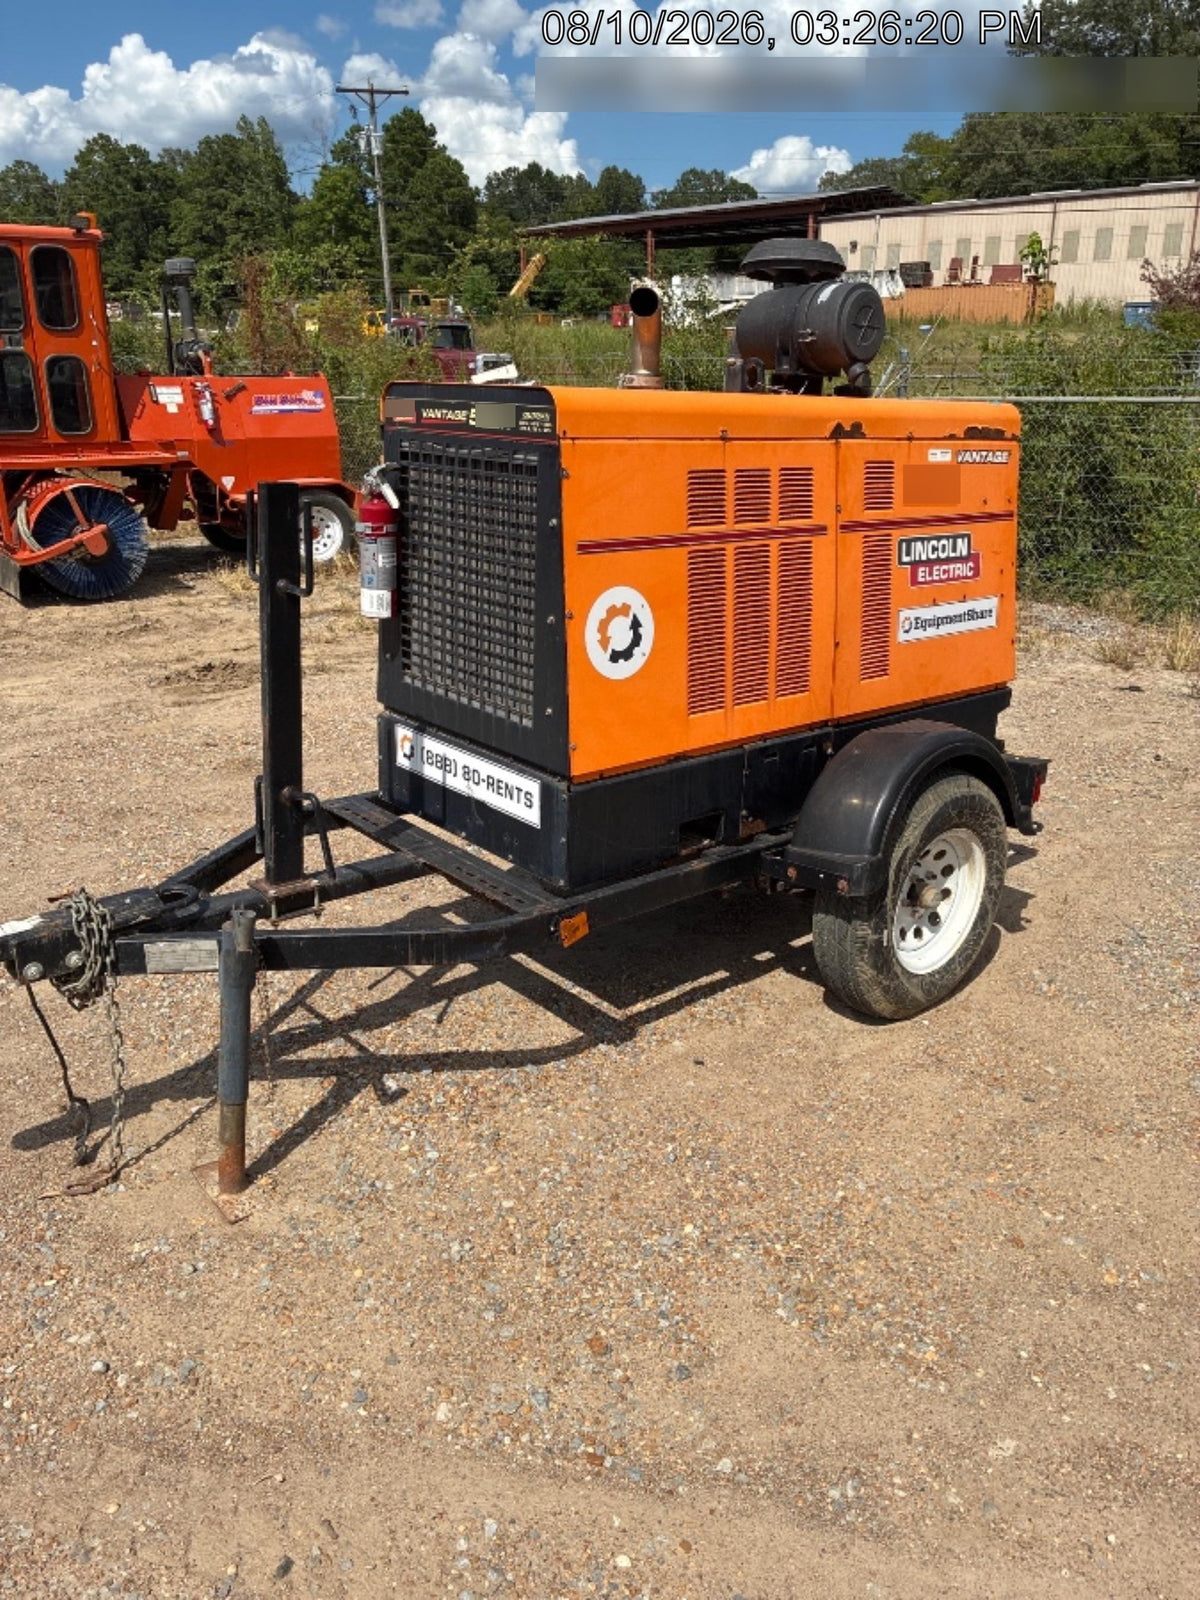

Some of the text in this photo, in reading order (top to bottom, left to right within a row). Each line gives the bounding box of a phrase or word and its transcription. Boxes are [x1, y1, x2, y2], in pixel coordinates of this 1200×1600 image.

[421, 408, 469, 421] VANTAGE
[957, 449, 1010, 464] VANTAGE
[901, 537, 969, 562] LINCOLN
[917, 561, 974, 582] ELECTRIC
[914, 605, 993, 631] EquipmentShare
[421, 746, 534, 809] (888) 80-RENTS
